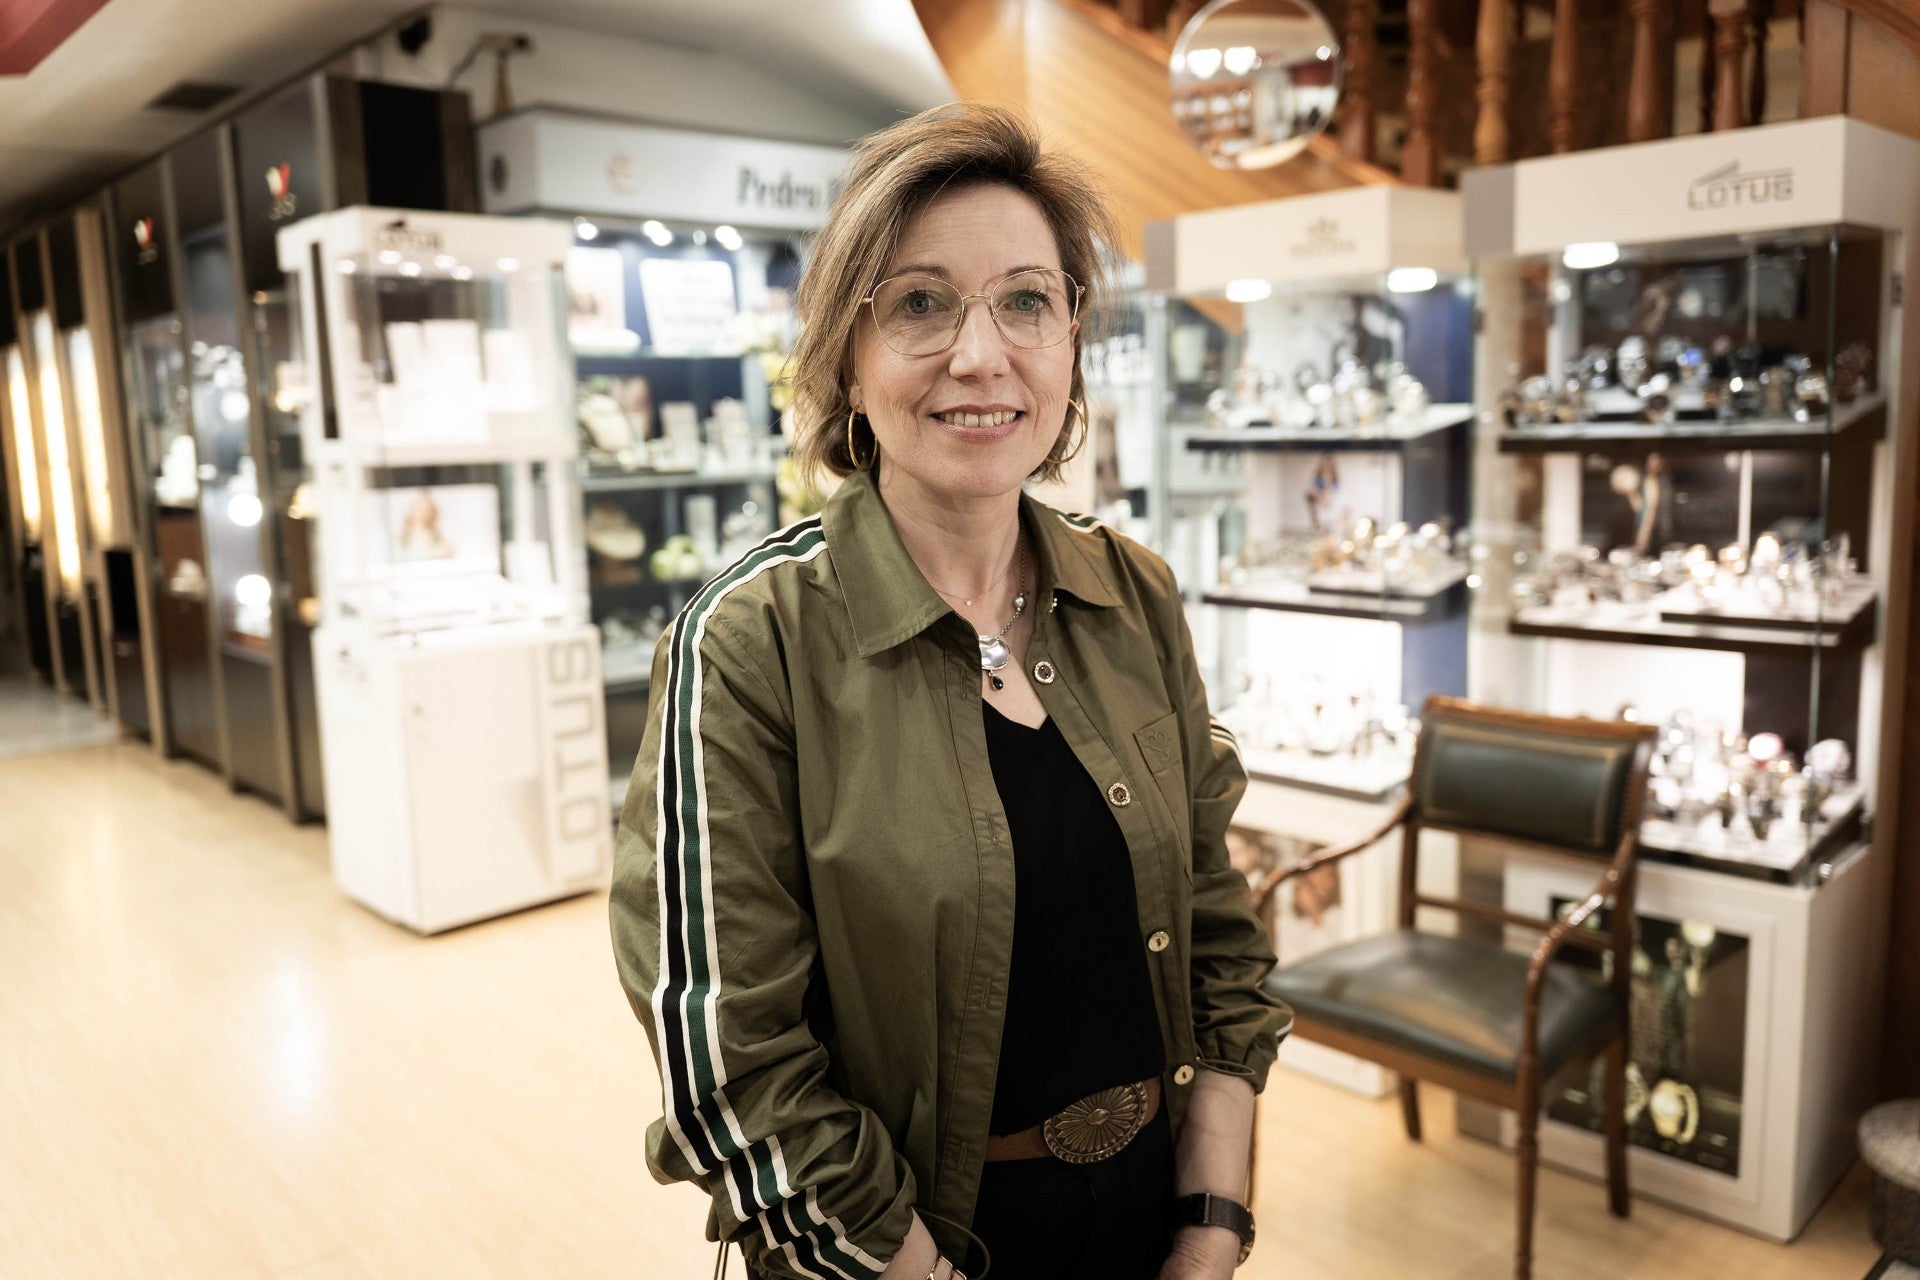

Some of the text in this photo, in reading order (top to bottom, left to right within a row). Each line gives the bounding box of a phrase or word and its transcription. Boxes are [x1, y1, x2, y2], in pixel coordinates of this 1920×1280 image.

[737, 165, 819, 208] Pedro
[1687, 174, 1794, 212] LOTUS
[549, 639, 604, 888] LOTUS
